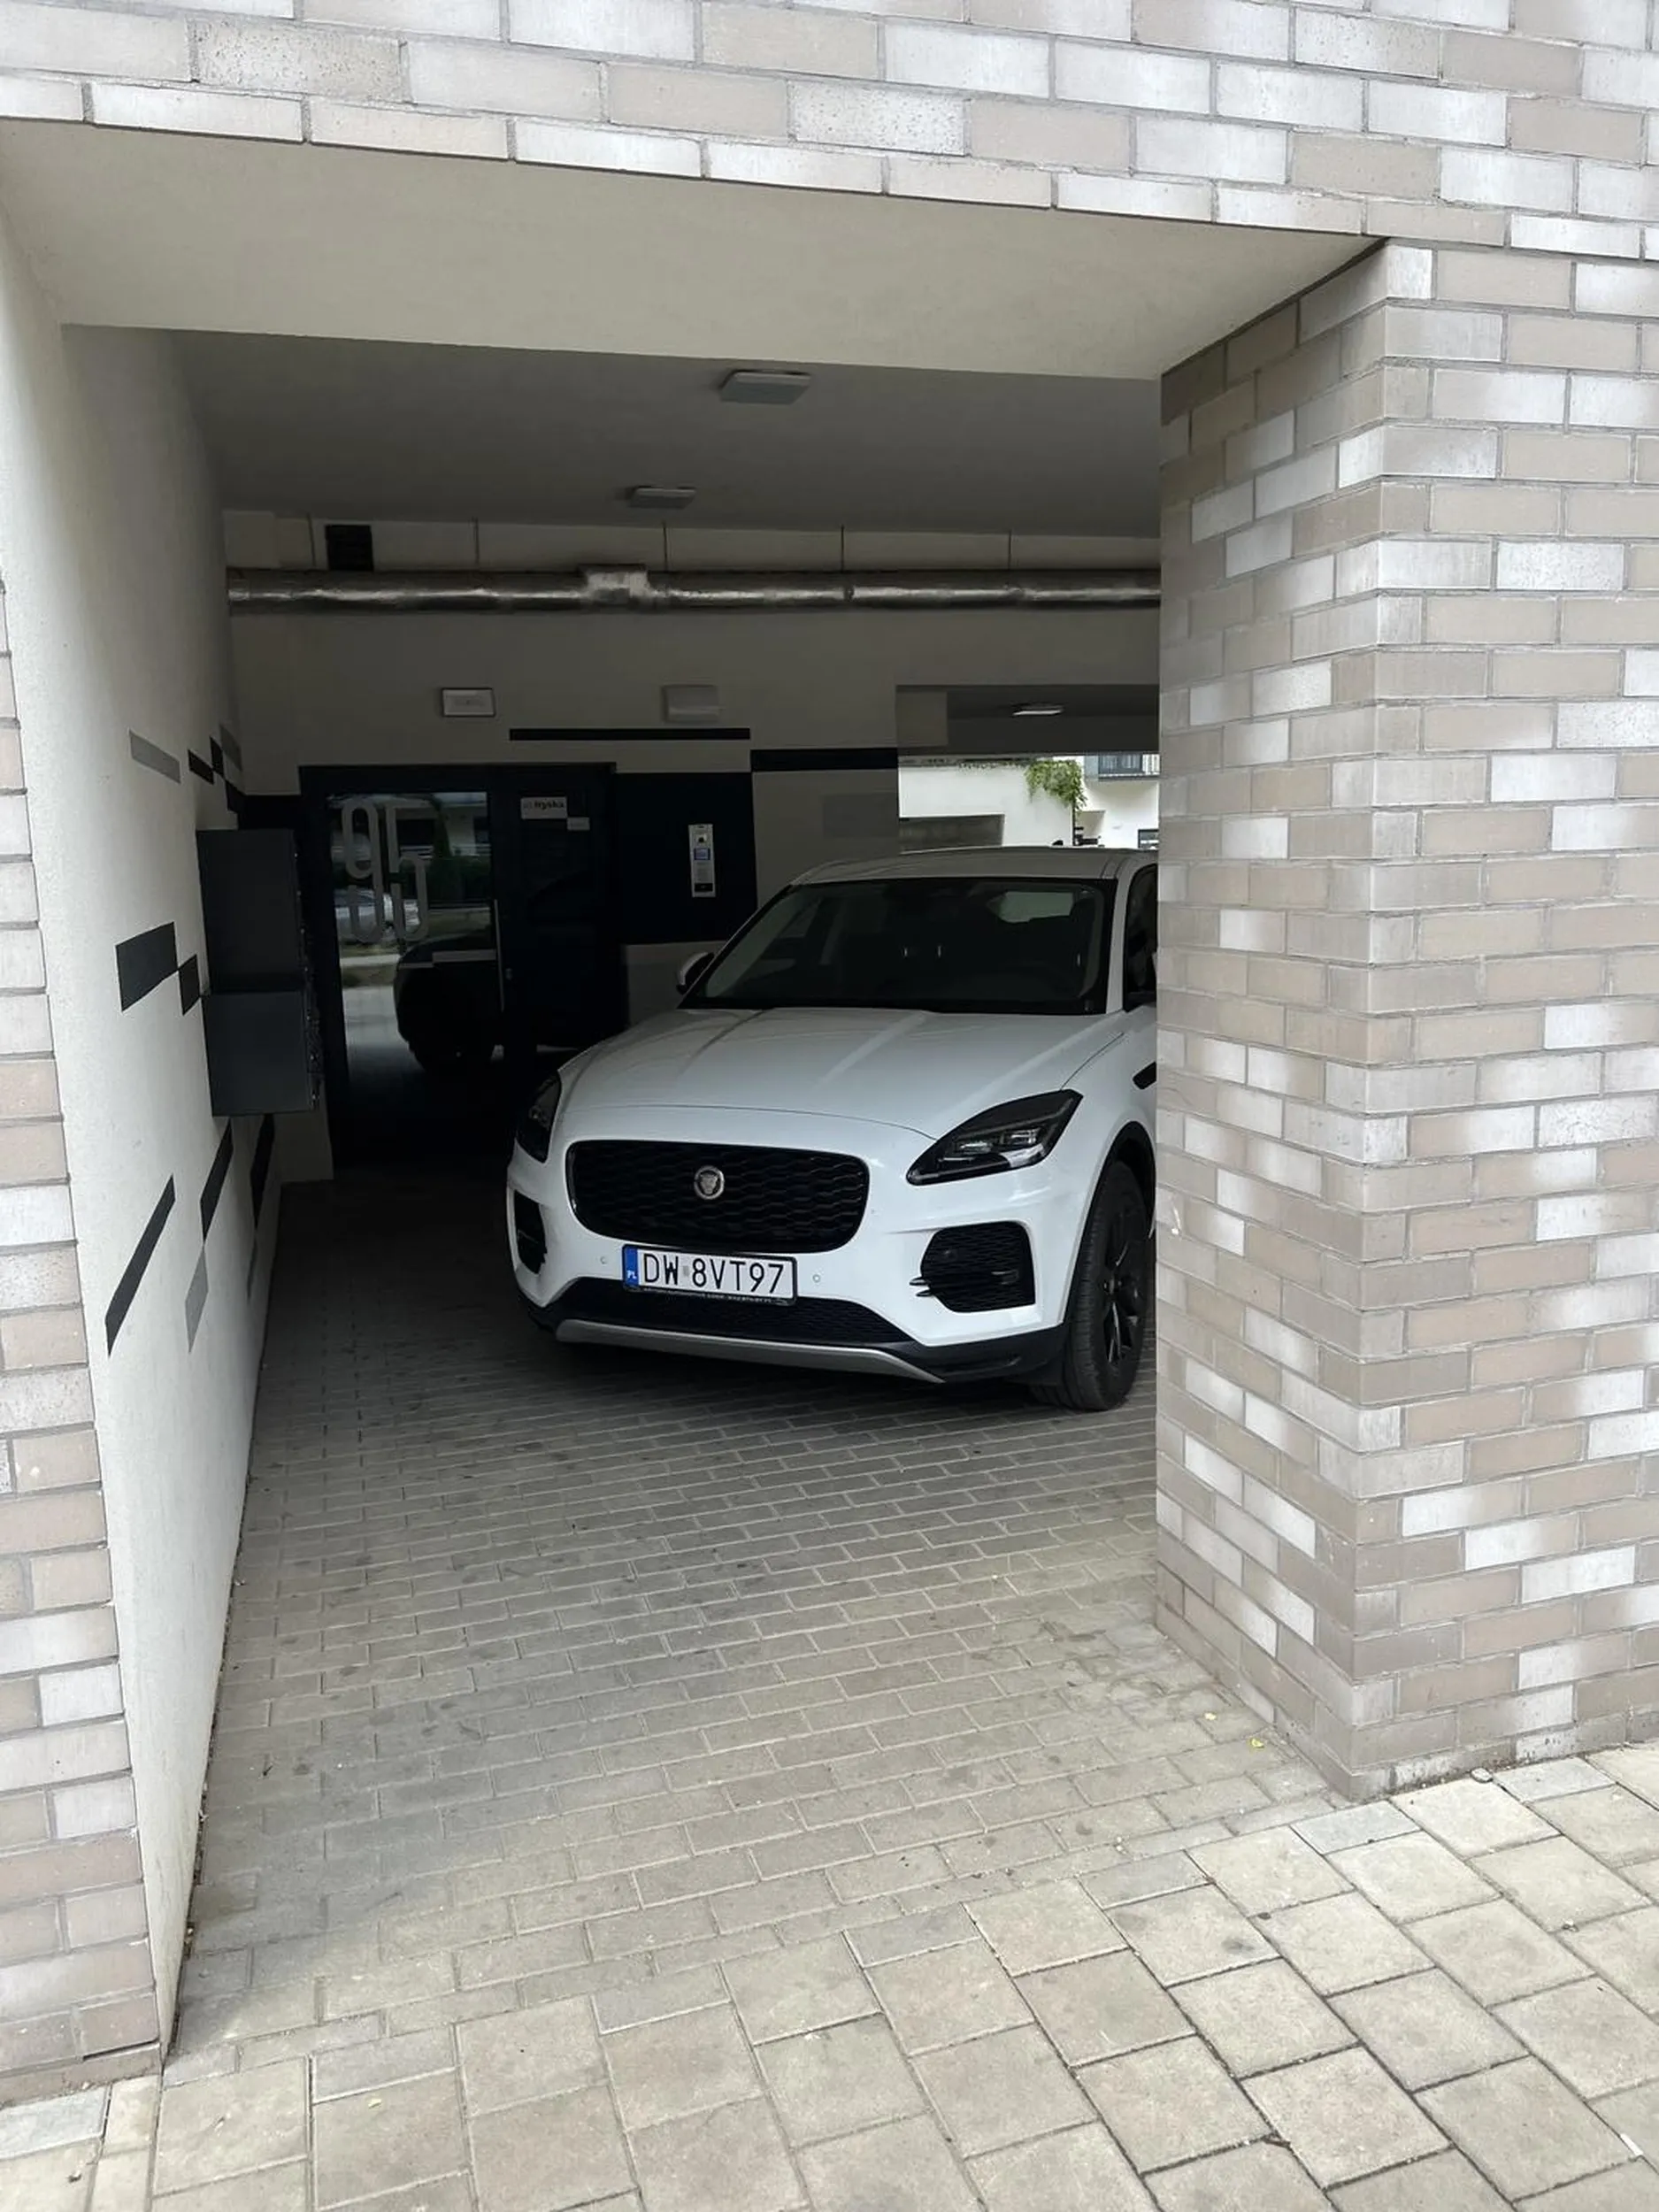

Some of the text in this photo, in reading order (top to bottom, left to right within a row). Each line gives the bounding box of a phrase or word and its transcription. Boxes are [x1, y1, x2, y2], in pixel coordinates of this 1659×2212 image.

[342, 797, 431, 944] 95
[643, 1253, 784, 1294] DW 8VT97
